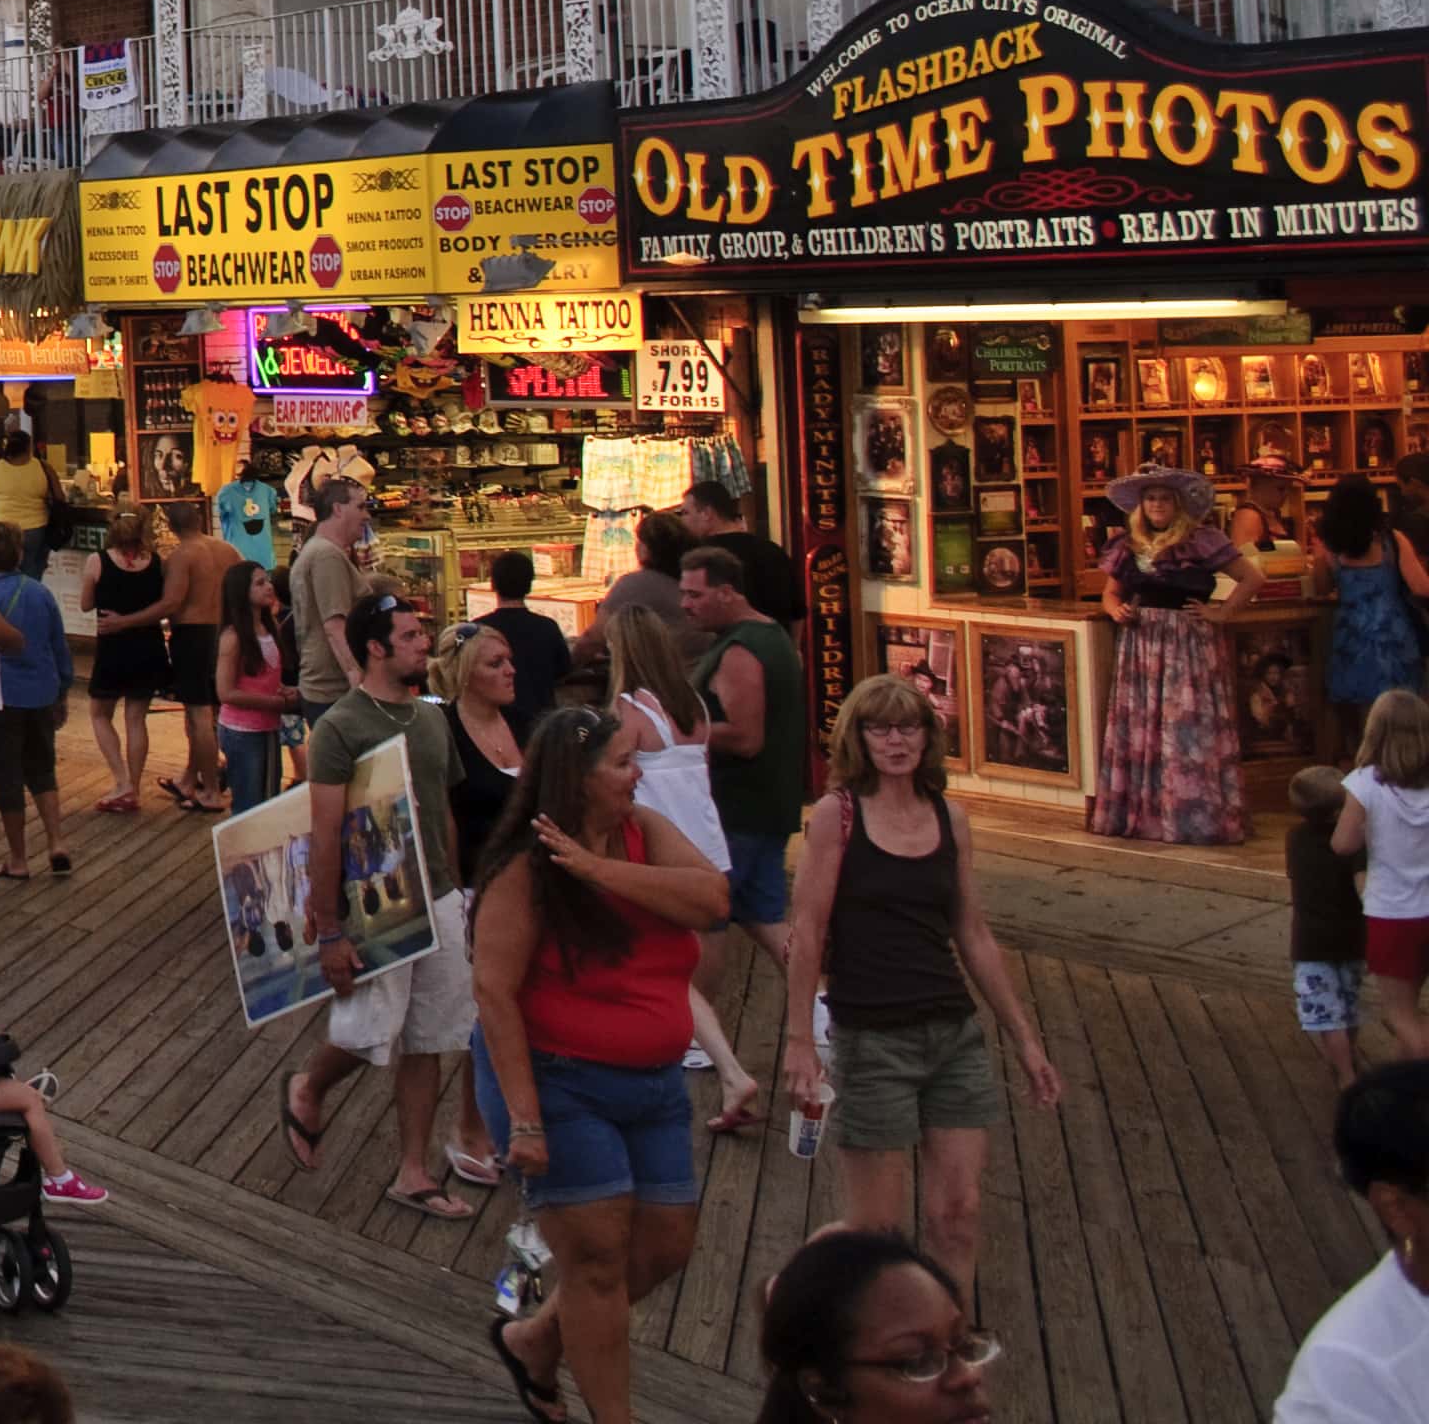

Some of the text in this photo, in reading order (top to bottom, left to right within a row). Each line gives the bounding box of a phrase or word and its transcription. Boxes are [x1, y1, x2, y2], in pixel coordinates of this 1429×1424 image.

[806, 28, 883, 98] WELCOME
[886, 13, 910, 34] TO
[1043, 5, 1129, 60] ORIGINAL
[832, 21, 1045, 120] FLASHBACK
[633, 74, 1420, 224] OLD TIME PHOTOS
[445, 155, 600, 191] LAST STOP
[156, 173, 335, 237] LAST STOP
[346, 208, 422, 224] HENNA TATTOO
[435, 195, 616, 220] STOP BEACHWEAR STOP
[86, 225, 147, 238] HENNA TATTOO
[439, 230, 618, 254] BODY ERCING
[640, 197, 1420, 263] FAMILY, GROUP, & CHILDREN'S PORTRAITS READY IN MINUTES
[88, 249, 140, 262] ACCESSORIES
[346, 237, 425, 253] SMOKE PRODUCTS
[154, 250, 342, 287] STOP BEACHWEAR STOP
[350, 266, 426, 281] URBAN FASHION
[467, 267, 483, 284] &
[468, 299, 632, 332] HENNA TATTOO
[265, 346, 280, 376] &
[650, 345, 711, 357] SHORTS
[276, 400, 352, 424] EAR PIERCING
[642, 395, 653, 406] 2
[660, 395, 693, 407] FOR
[814, 431, 837, 529] MINUTES
